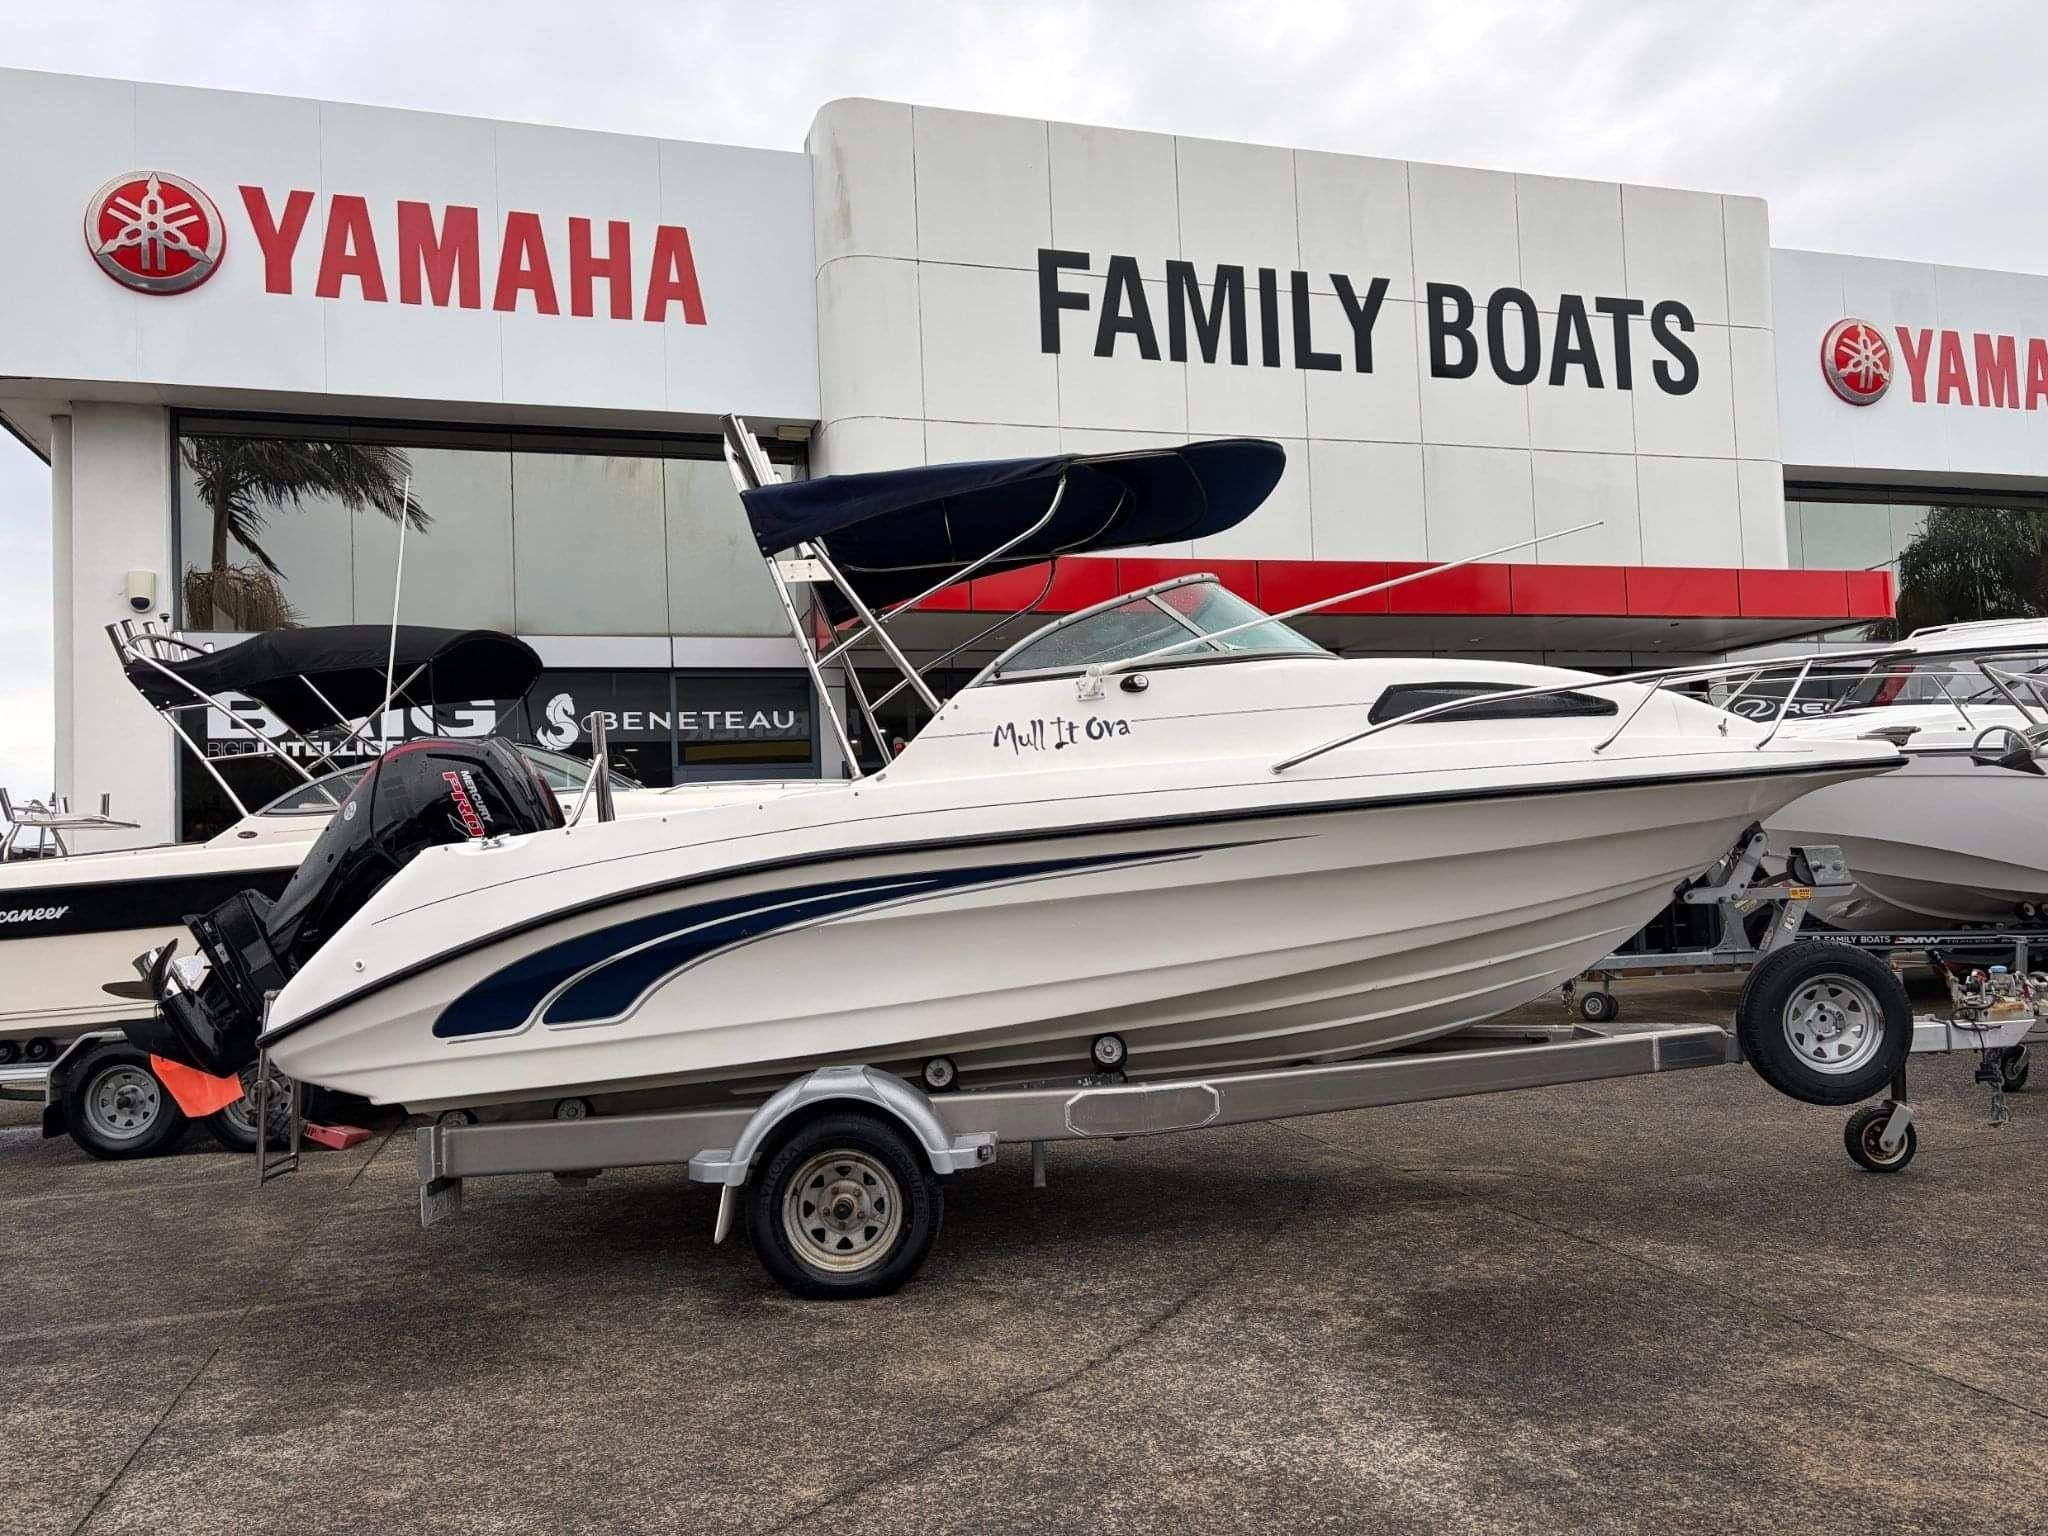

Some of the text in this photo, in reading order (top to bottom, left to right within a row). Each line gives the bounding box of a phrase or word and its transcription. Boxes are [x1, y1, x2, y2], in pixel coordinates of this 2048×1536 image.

[238, 185, 707, 325] YAMAHA
[1037, 248, 1700, 396] FAMILY BOATS
[603, 710, 794, 730] BENETEAU
[993, 716, 1131, 755] Mull It Ova
[442, 771, 485, 837] PRO
[460, 770, 494, 823] MERCURY
[0, 905, 69, 923] caneer
[1860, 935, 1890, 944] BOATS
